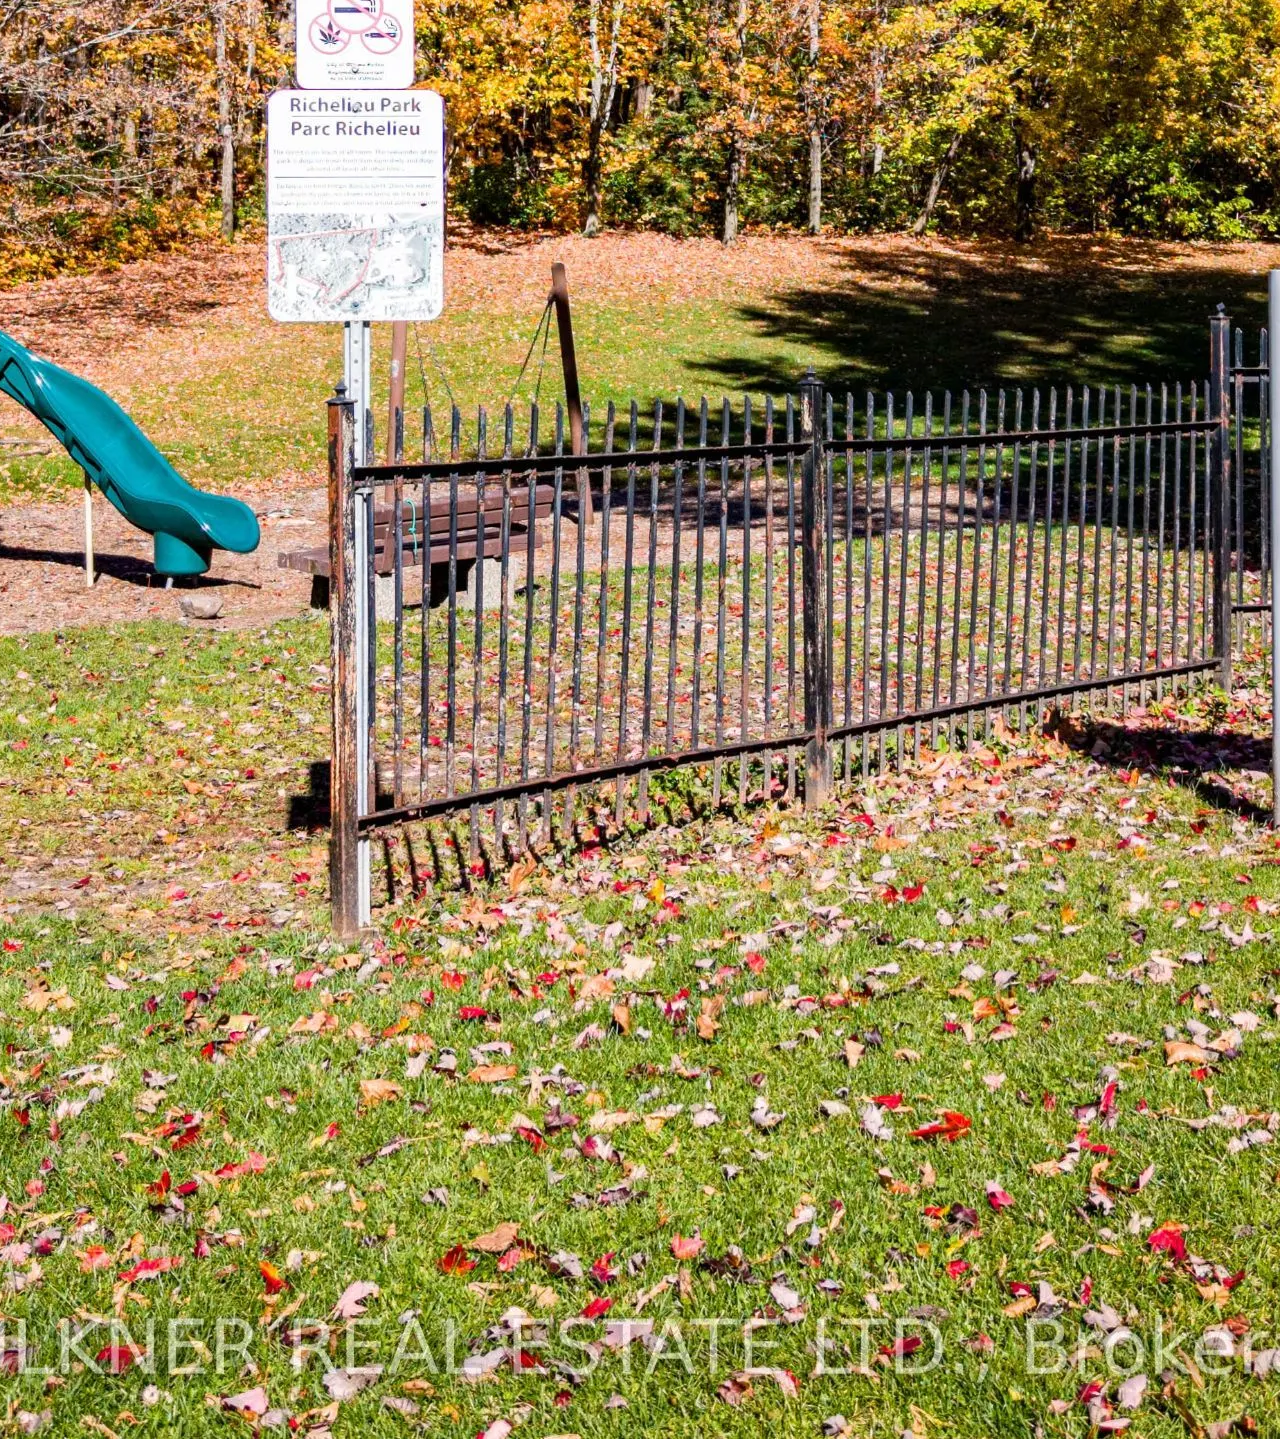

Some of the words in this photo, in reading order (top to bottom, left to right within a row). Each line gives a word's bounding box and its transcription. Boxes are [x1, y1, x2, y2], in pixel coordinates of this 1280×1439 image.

[380, 97, 421, 112] Park
[292, 122, 330, 136] Parc
[336, 121, 420, 136] Richelieu
